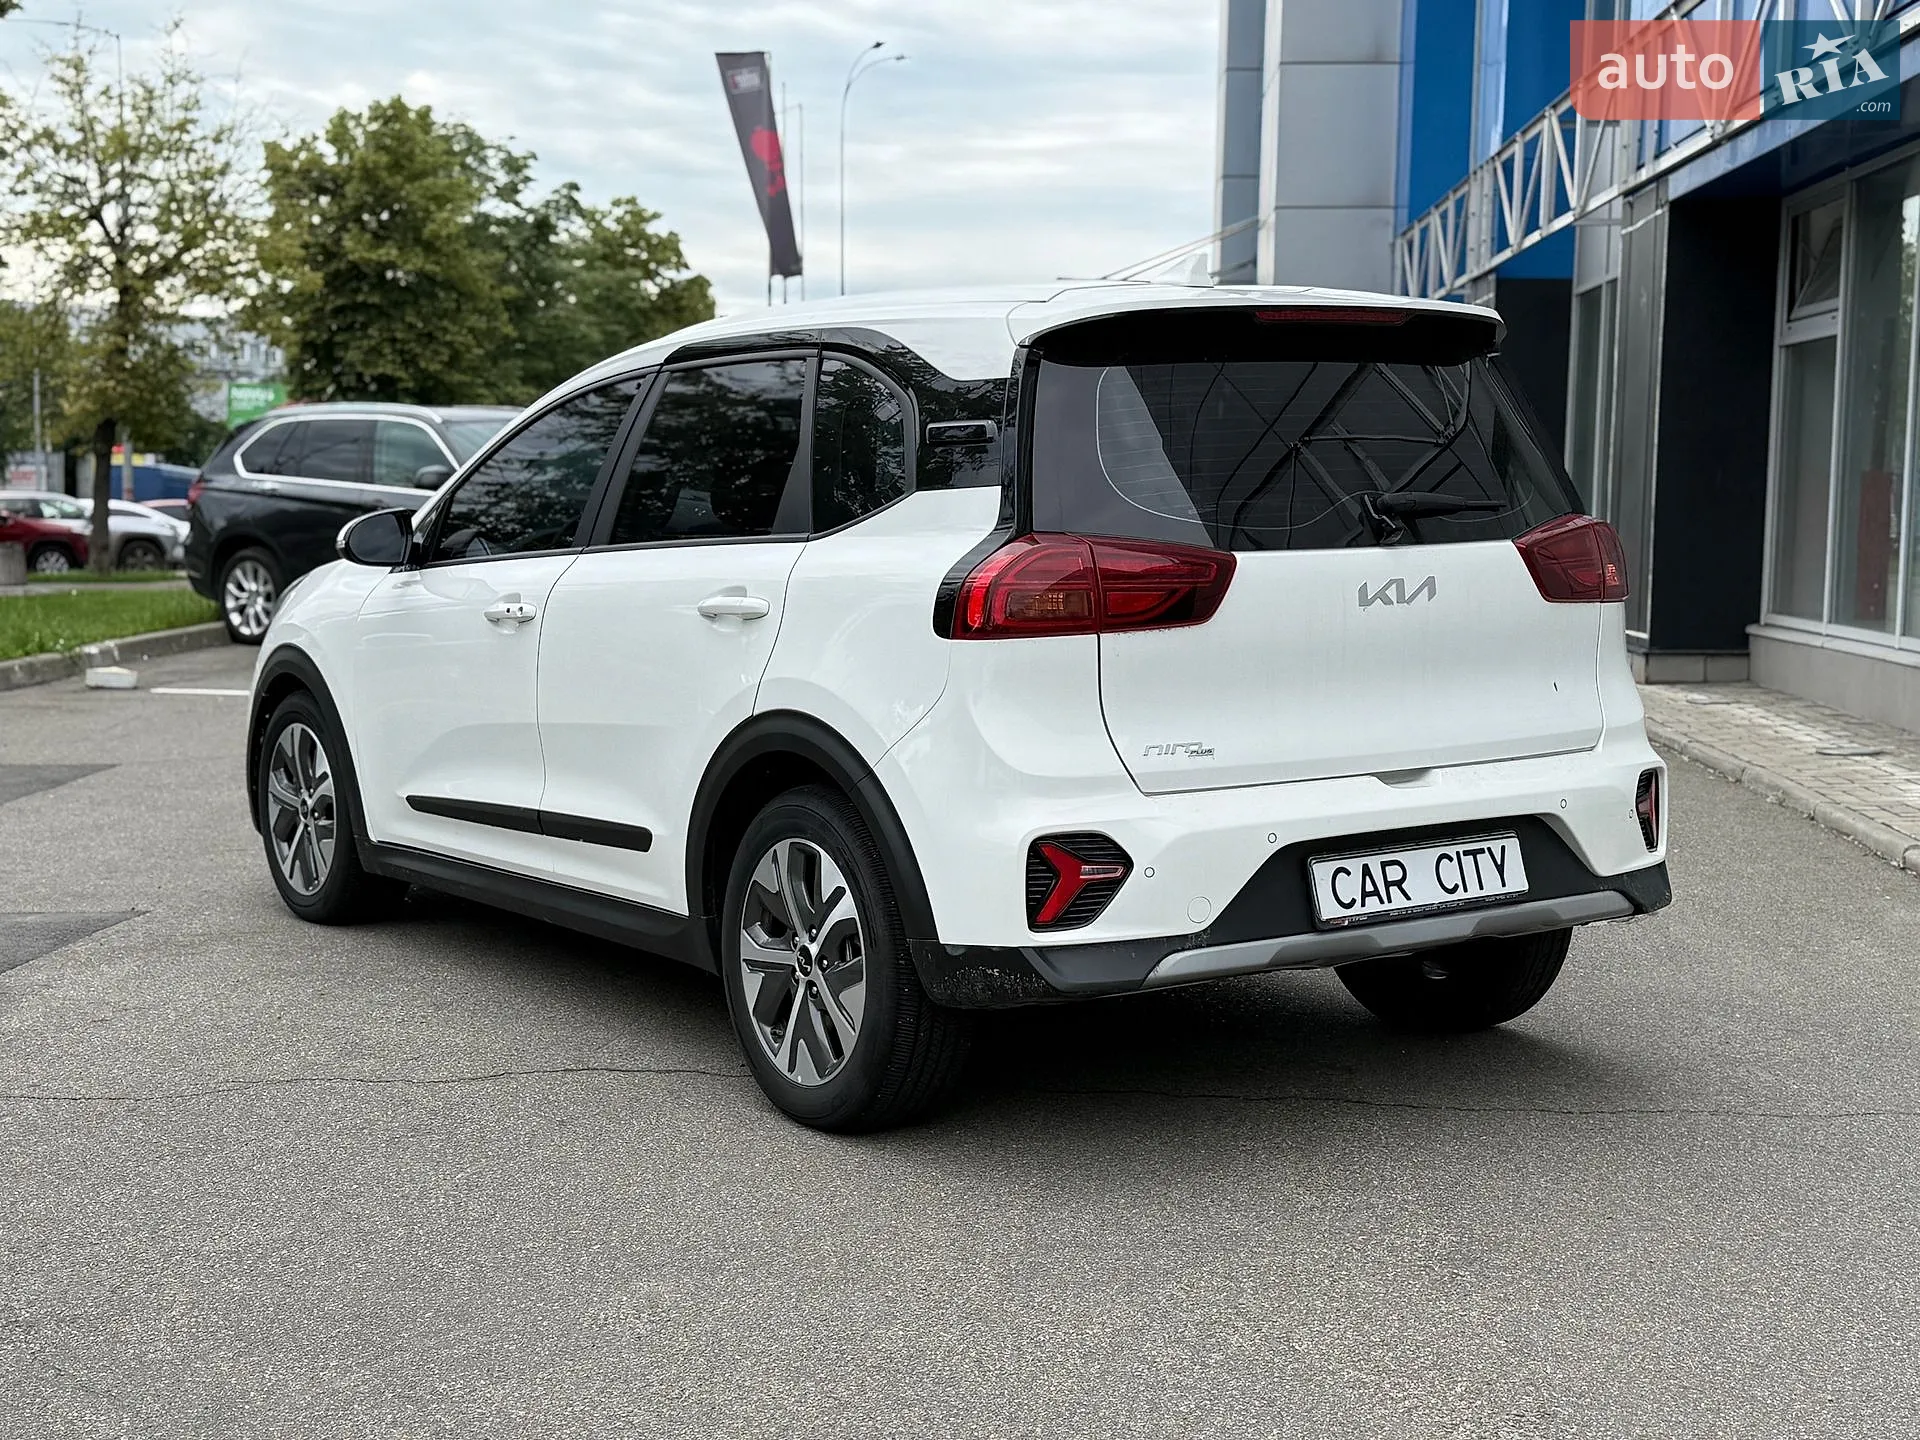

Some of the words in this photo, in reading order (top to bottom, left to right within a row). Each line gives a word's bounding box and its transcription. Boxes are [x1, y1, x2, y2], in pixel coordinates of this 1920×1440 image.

[1358, 575, 1437, 607] KIA
[1330, 859, 1412, 910] CAR
[1434, 844, 1507, 895] CITY
